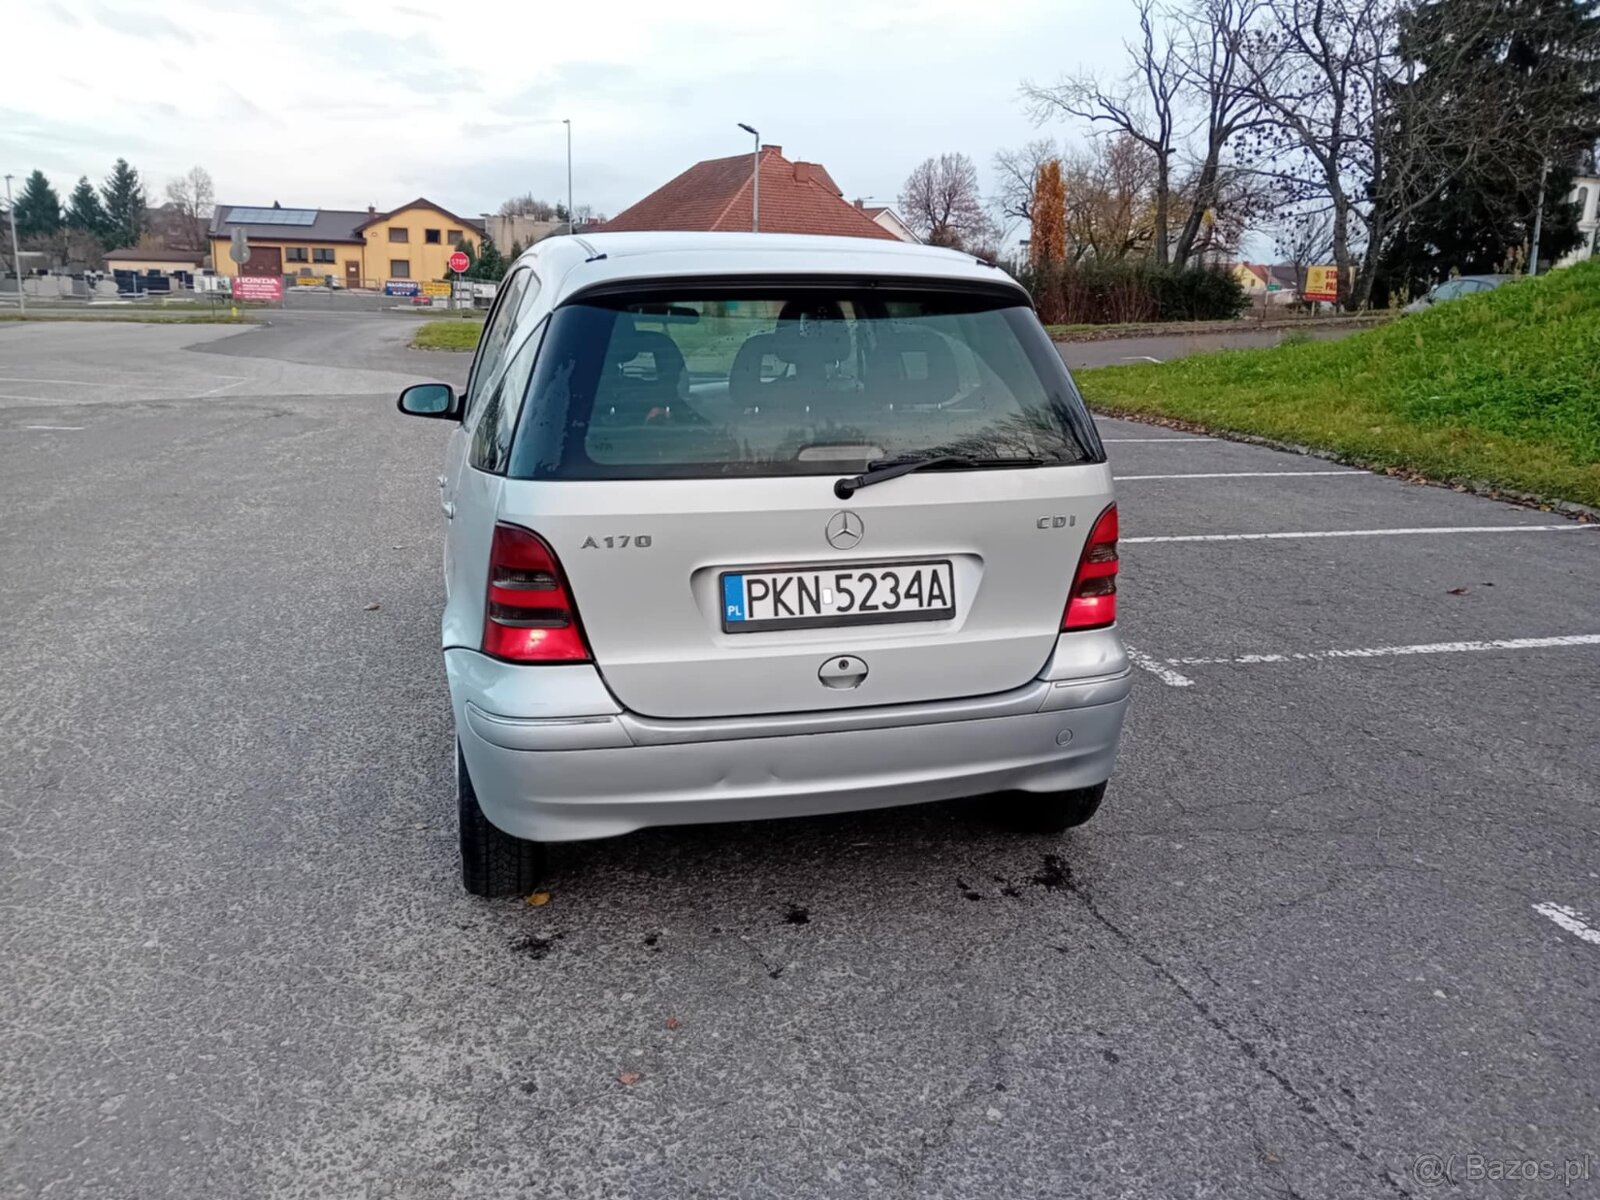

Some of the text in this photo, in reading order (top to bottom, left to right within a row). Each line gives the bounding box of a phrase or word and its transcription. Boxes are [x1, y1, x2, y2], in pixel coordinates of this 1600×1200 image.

[235, 277, 279, 285] HONDA
[1036, 515, 1076, 529] CDI
[746, 568, 948, 618] PKN 5234A
[727, 605, 742, 617] PL
